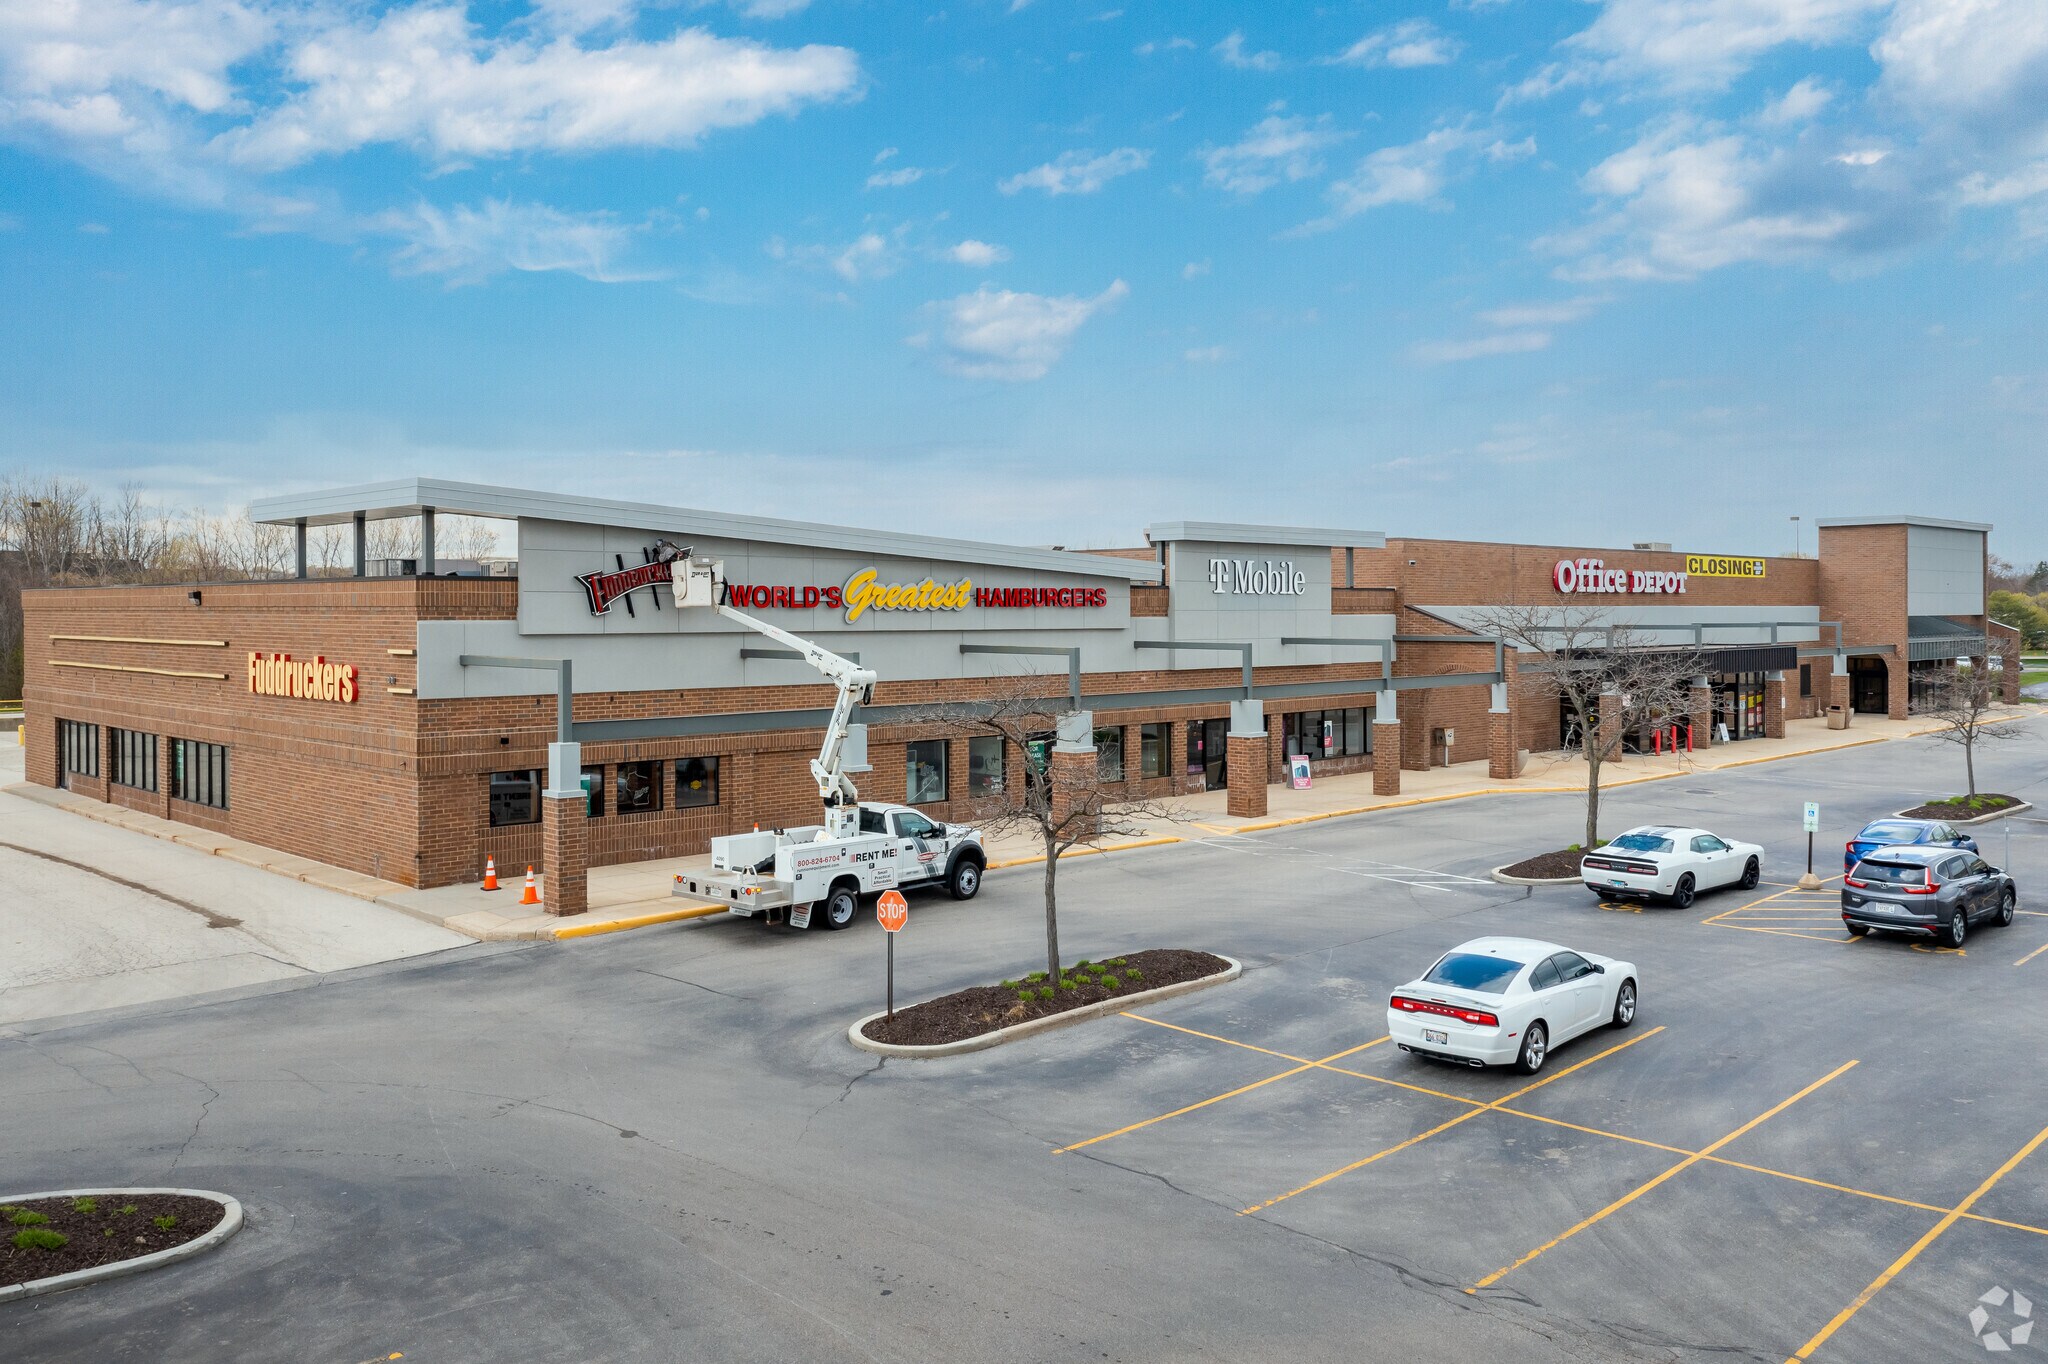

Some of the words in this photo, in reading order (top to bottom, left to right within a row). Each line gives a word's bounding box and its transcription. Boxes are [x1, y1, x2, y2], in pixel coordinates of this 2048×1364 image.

[1554, 558, 1627, 593] Office
[1629, 571, 1688, 593] DEPOT
[1688, 557, 1752, 576] CLOSING
[729, 585, 842, 609] WORLD'S
[845, 567, 972, 623] Greatest
[975, 587, 1108, 608] HAMBURGERS
[248, 652, 358, 703] Fuddruckers
[797, 855, 840, 867] 800-824-6704
[855, 851, 879, 862] RENT
[881, 848, 897, 859] ME!
[879, 903, 906, 919] STOP
